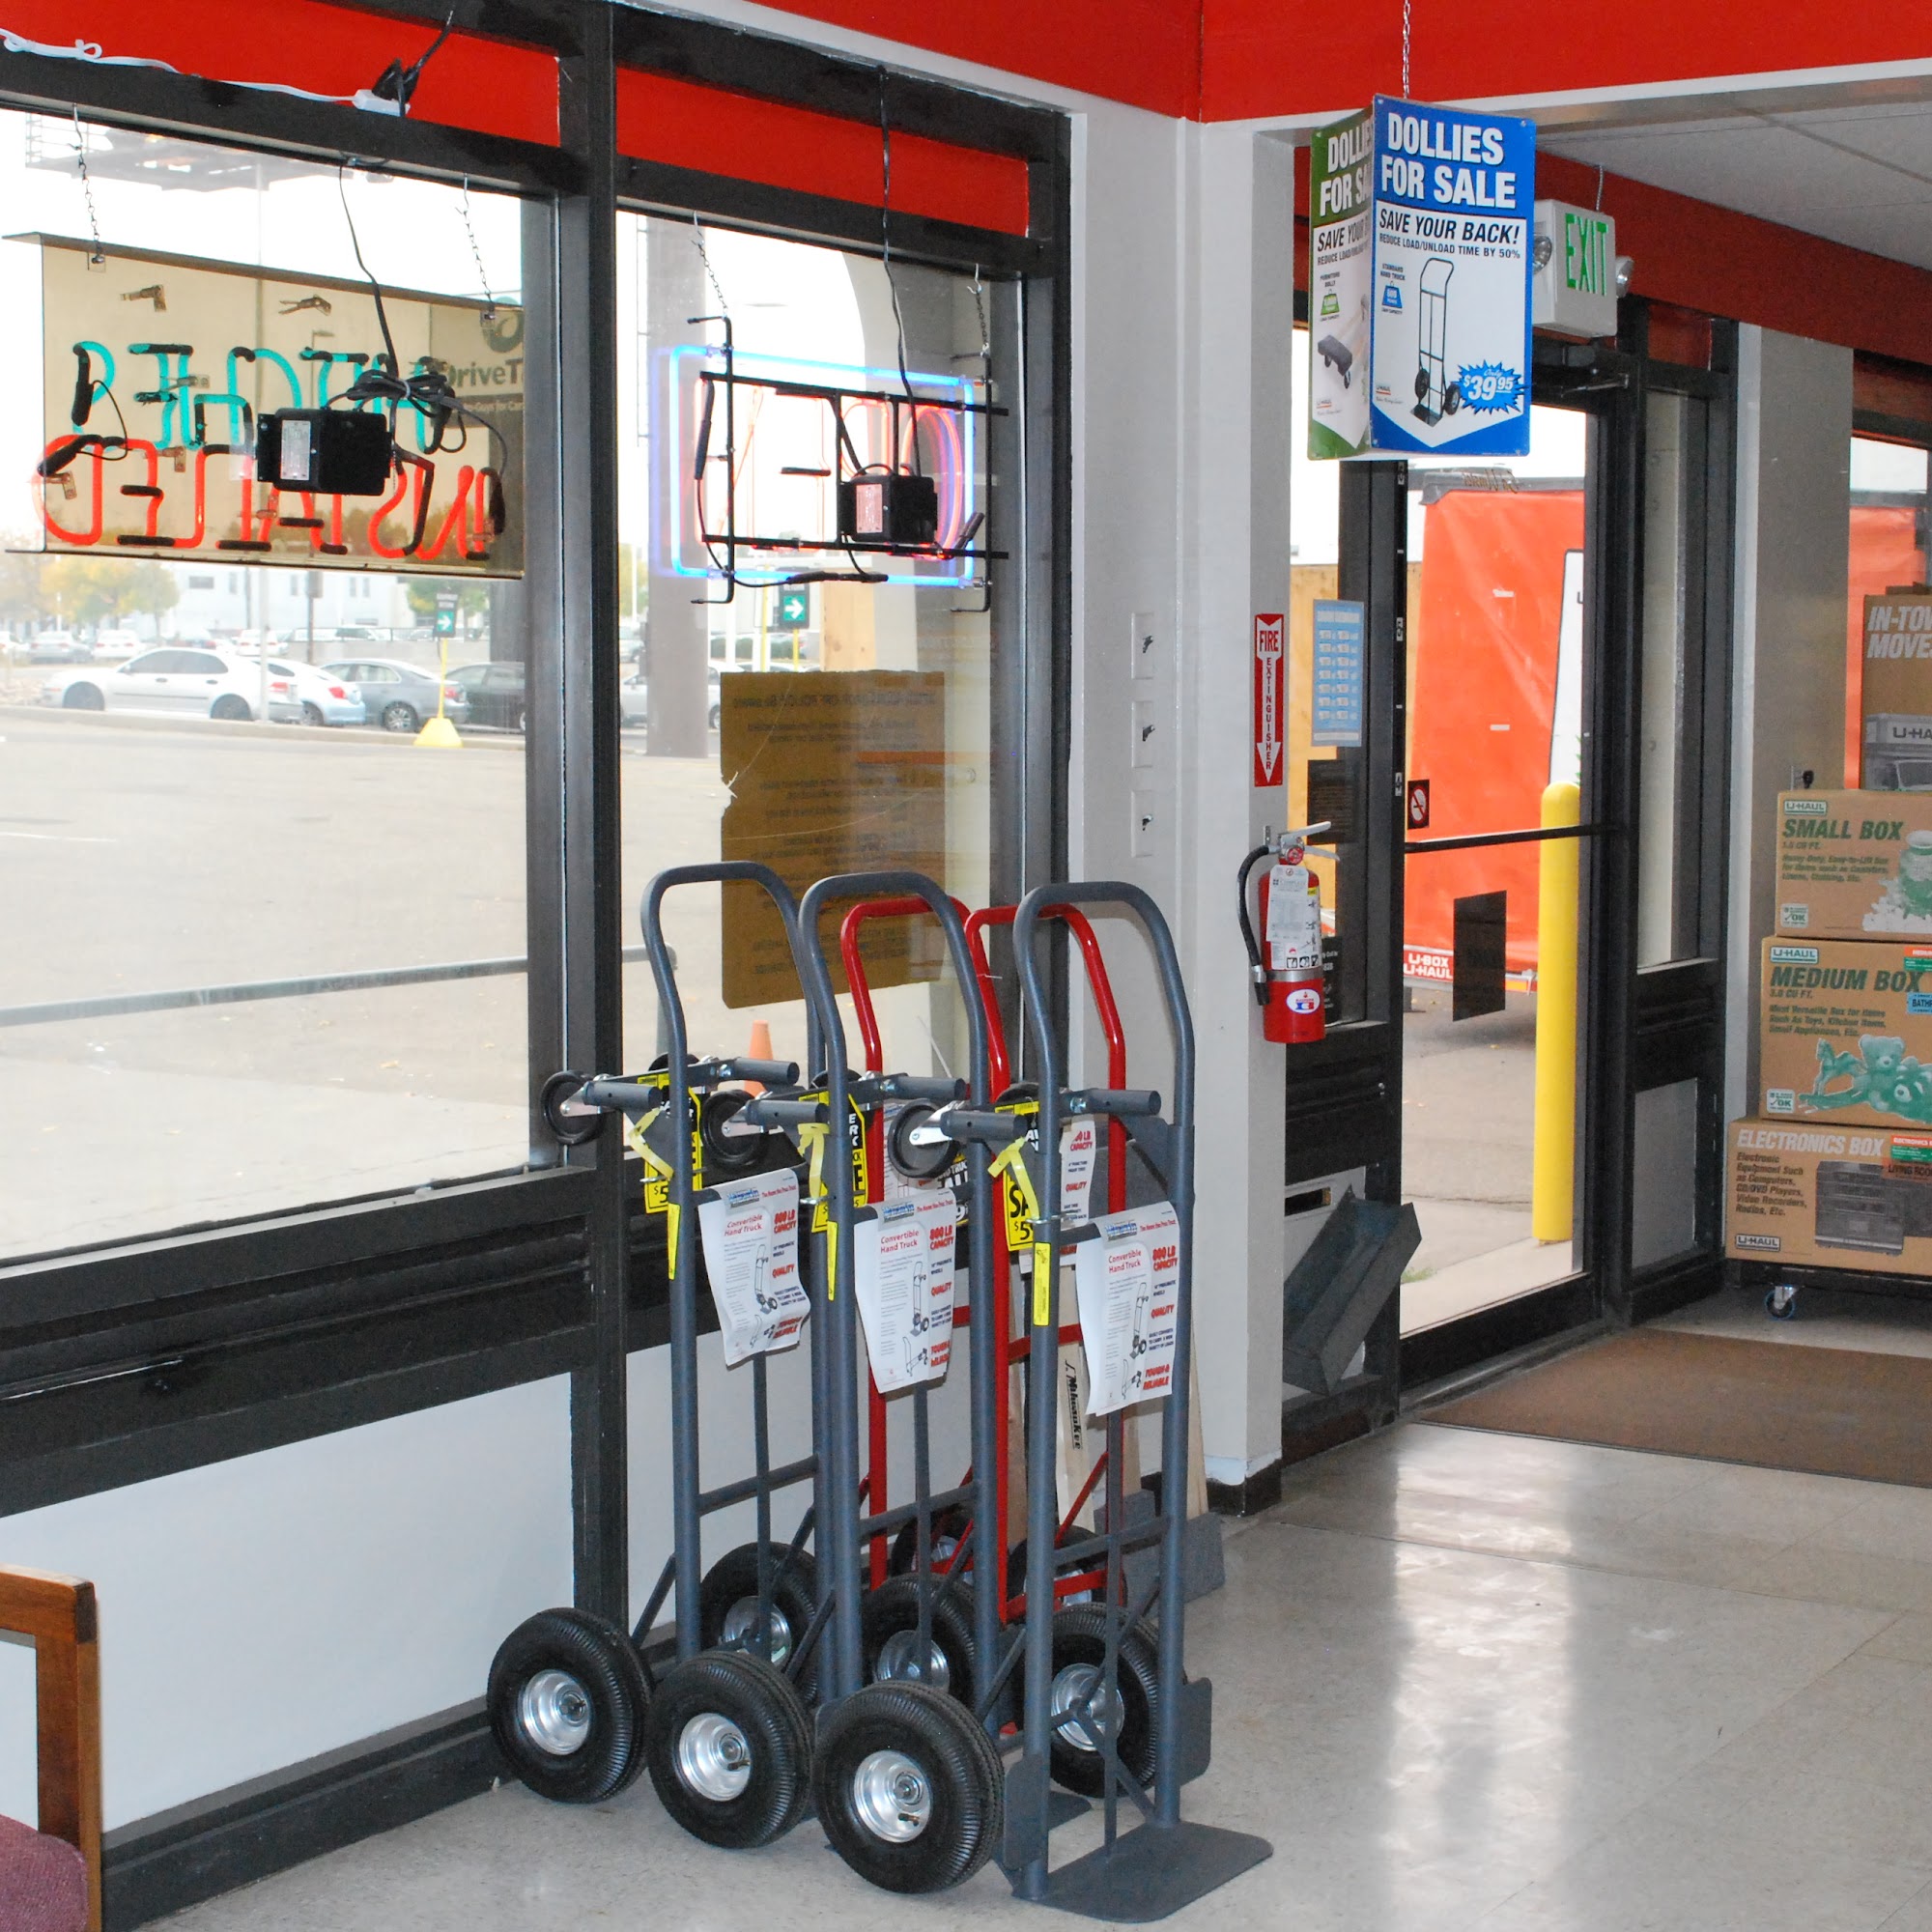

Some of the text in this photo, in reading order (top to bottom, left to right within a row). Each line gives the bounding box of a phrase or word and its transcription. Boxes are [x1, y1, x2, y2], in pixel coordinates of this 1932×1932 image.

[1328, 116, 1373, 174] DOLLIE
[1387, 112, 1504, 165] DOLLIES
[1381, 154, 1516, 210] FOR SALE
[1320, 173, 1352, 217] FOR
[1379, 209, 1520, 244] SAVE YOUR BACK!
[1318, 227, 1349, 252] SAVE
[1379, 233, 1520, 259] REDUCE LOAD/UNLOAD TIME BY 50%
[1317, 252, 1338, 266] REDUCE
[1565, 212, 1608, 297] EXIT
[1259, 631, 1279, 652] FIRE
[1786, 802, 1825, 810] U-HAUL
[1782, 818, 1904, 840] SMALL BOX
[1408, 953, 1449, 968] U-BOX
[1773, 949, 1816, 958] U-HAUL
[1404, 964, 1453, 979] U-HAUL
[1770, 966, 1924, 992] MEDIUM BOX
[1737, 1128, 1846, 1155] ELECTRONICS
[1849, 1137, 1884, 1156] BOX
[1737, 1151, 1779, 1163] Electronic
[1065, 1180, 1088, 1193] QUALITY
[726, 1213, 762, 1229] Convertible
[724, 1223, 762, 1236] Hand Truck
[881, 1230, 920, 1244] Convertible
[880, 1238, 918, 1254] Hand Truck
[1738, 1236, 1778, 1246] U-HAUL
[1108, 1248, 1142, 1264] Convertible
[772, 1264, 795, 1279] QUALITY
[1109, 1260, 1141, 1273] Hand Truck
[931, 1281, 952, 1296] QUALITY
[1151, 1304, 1175, 1320] QUALITY
